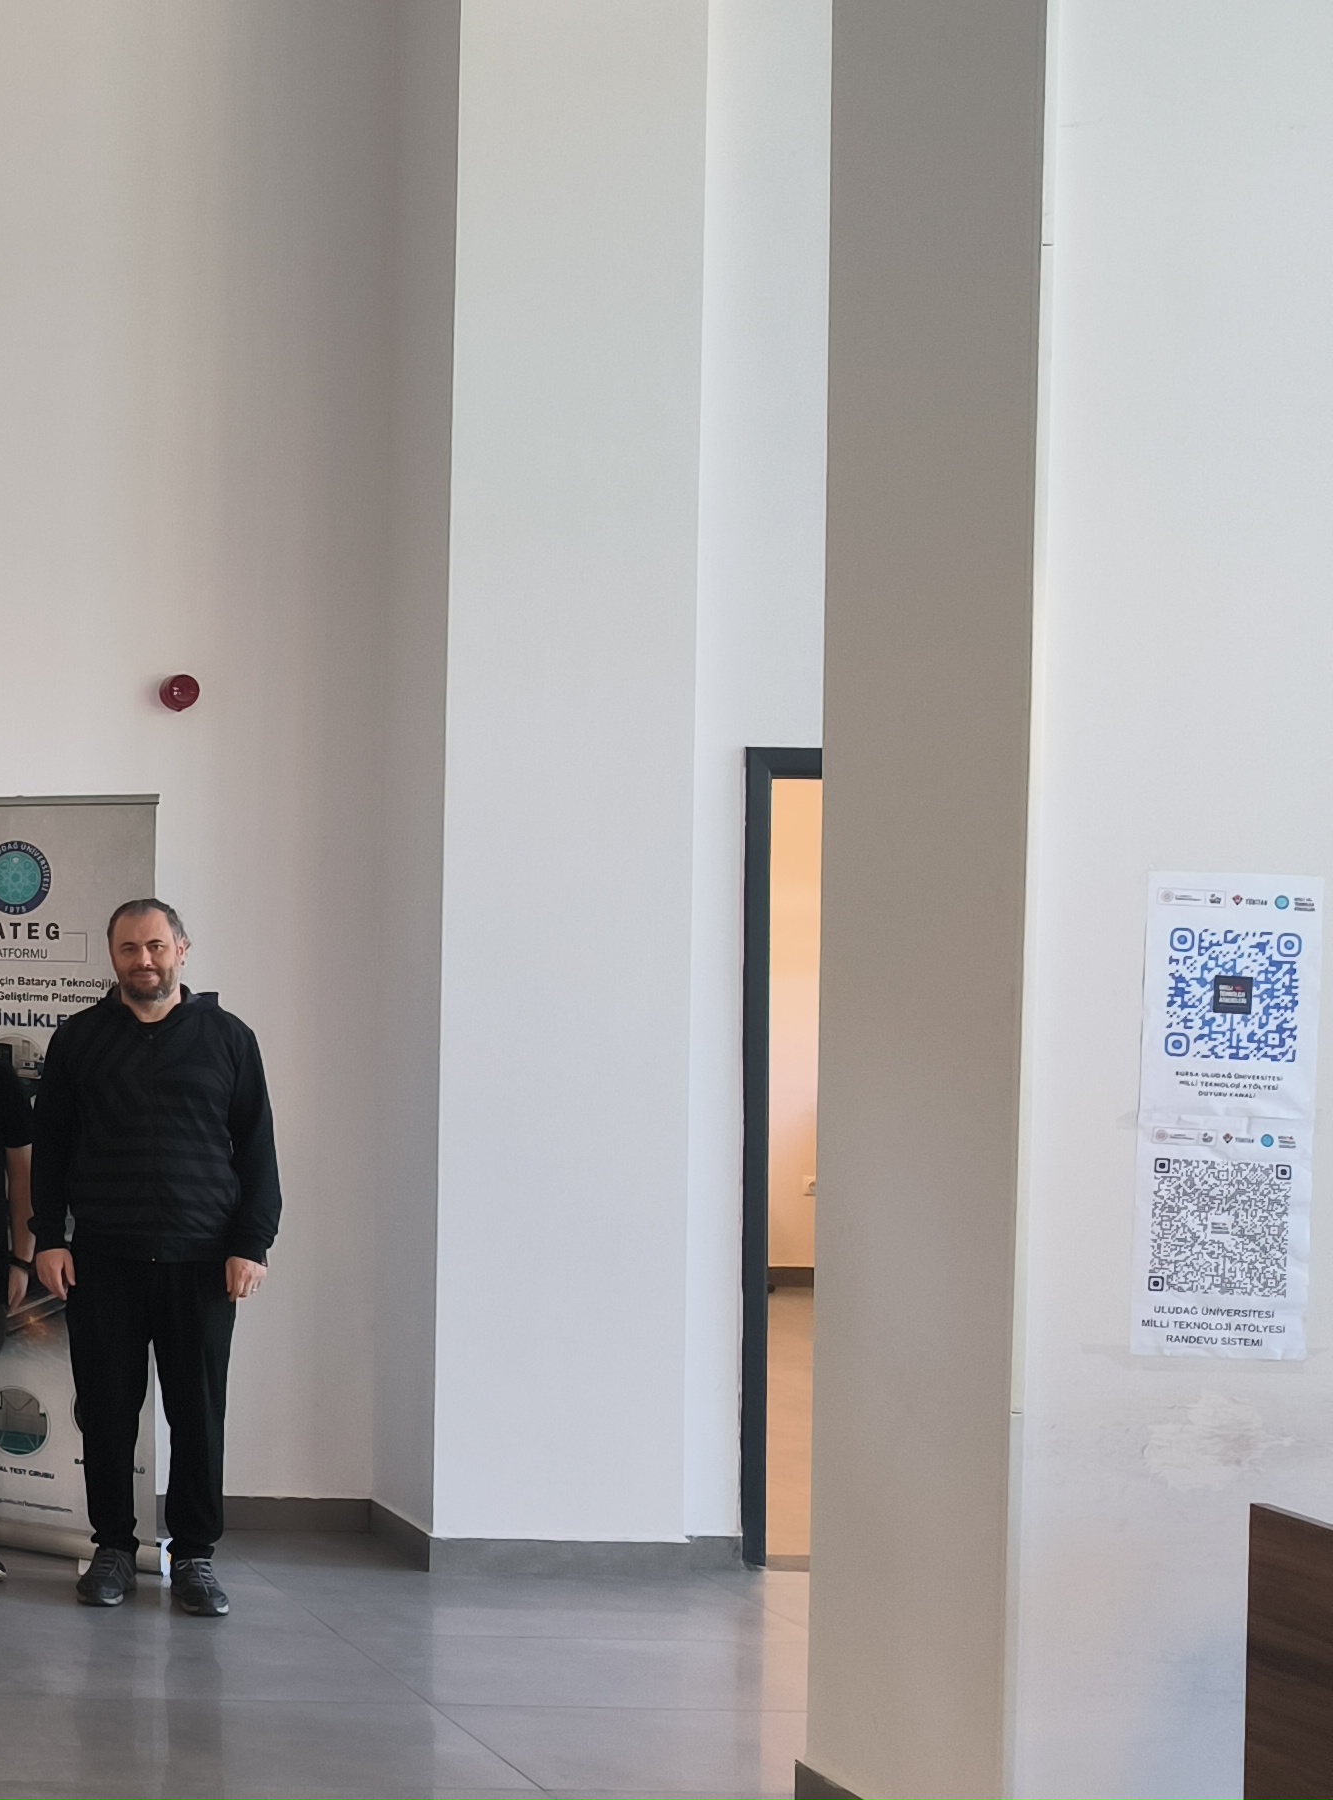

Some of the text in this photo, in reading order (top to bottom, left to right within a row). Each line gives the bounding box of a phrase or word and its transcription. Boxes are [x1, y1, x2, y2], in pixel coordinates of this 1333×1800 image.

[18, 976, 57, 988] Batarya
[1201, 1071, 1233, 1080] ULUDAĞ
[1153, 1305, 1275, 1319] ULUDAĞ ÜNİVERSİTESİ
[1141, 1319, 1170, 1329] MİLLİ
[1173, 1320, 1232, 1332] TEKNOLOJİ
[1165, 1334, 1264, 1347] RANDEVU SİSTEMİ
[9, 1467, 27, 1475] TEST
